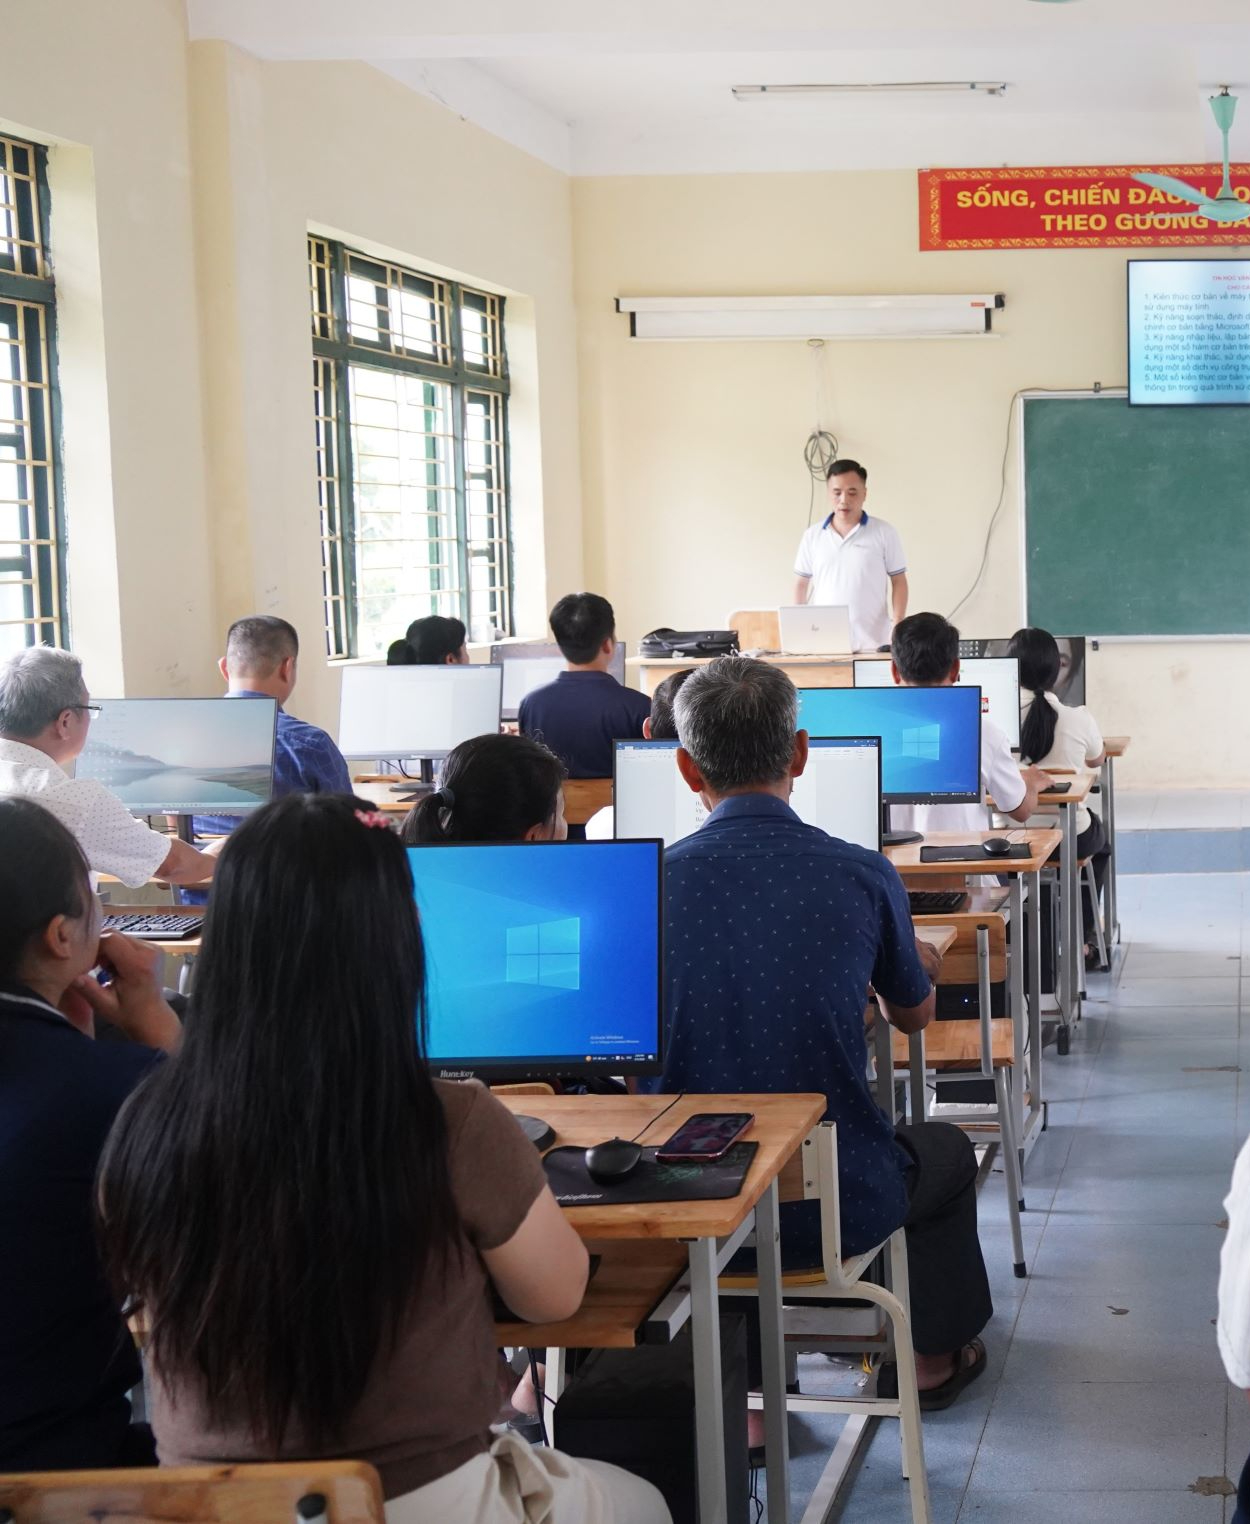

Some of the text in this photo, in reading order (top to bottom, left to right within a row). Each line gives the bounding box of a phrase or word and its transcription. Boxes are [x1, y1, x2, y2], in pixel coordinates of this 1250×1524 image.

[957, 183, 1036, 208] SỐNG,
[1044, 181, 1120, 206] CHIẾN
[1041, 214, 1107, 231] THEO
